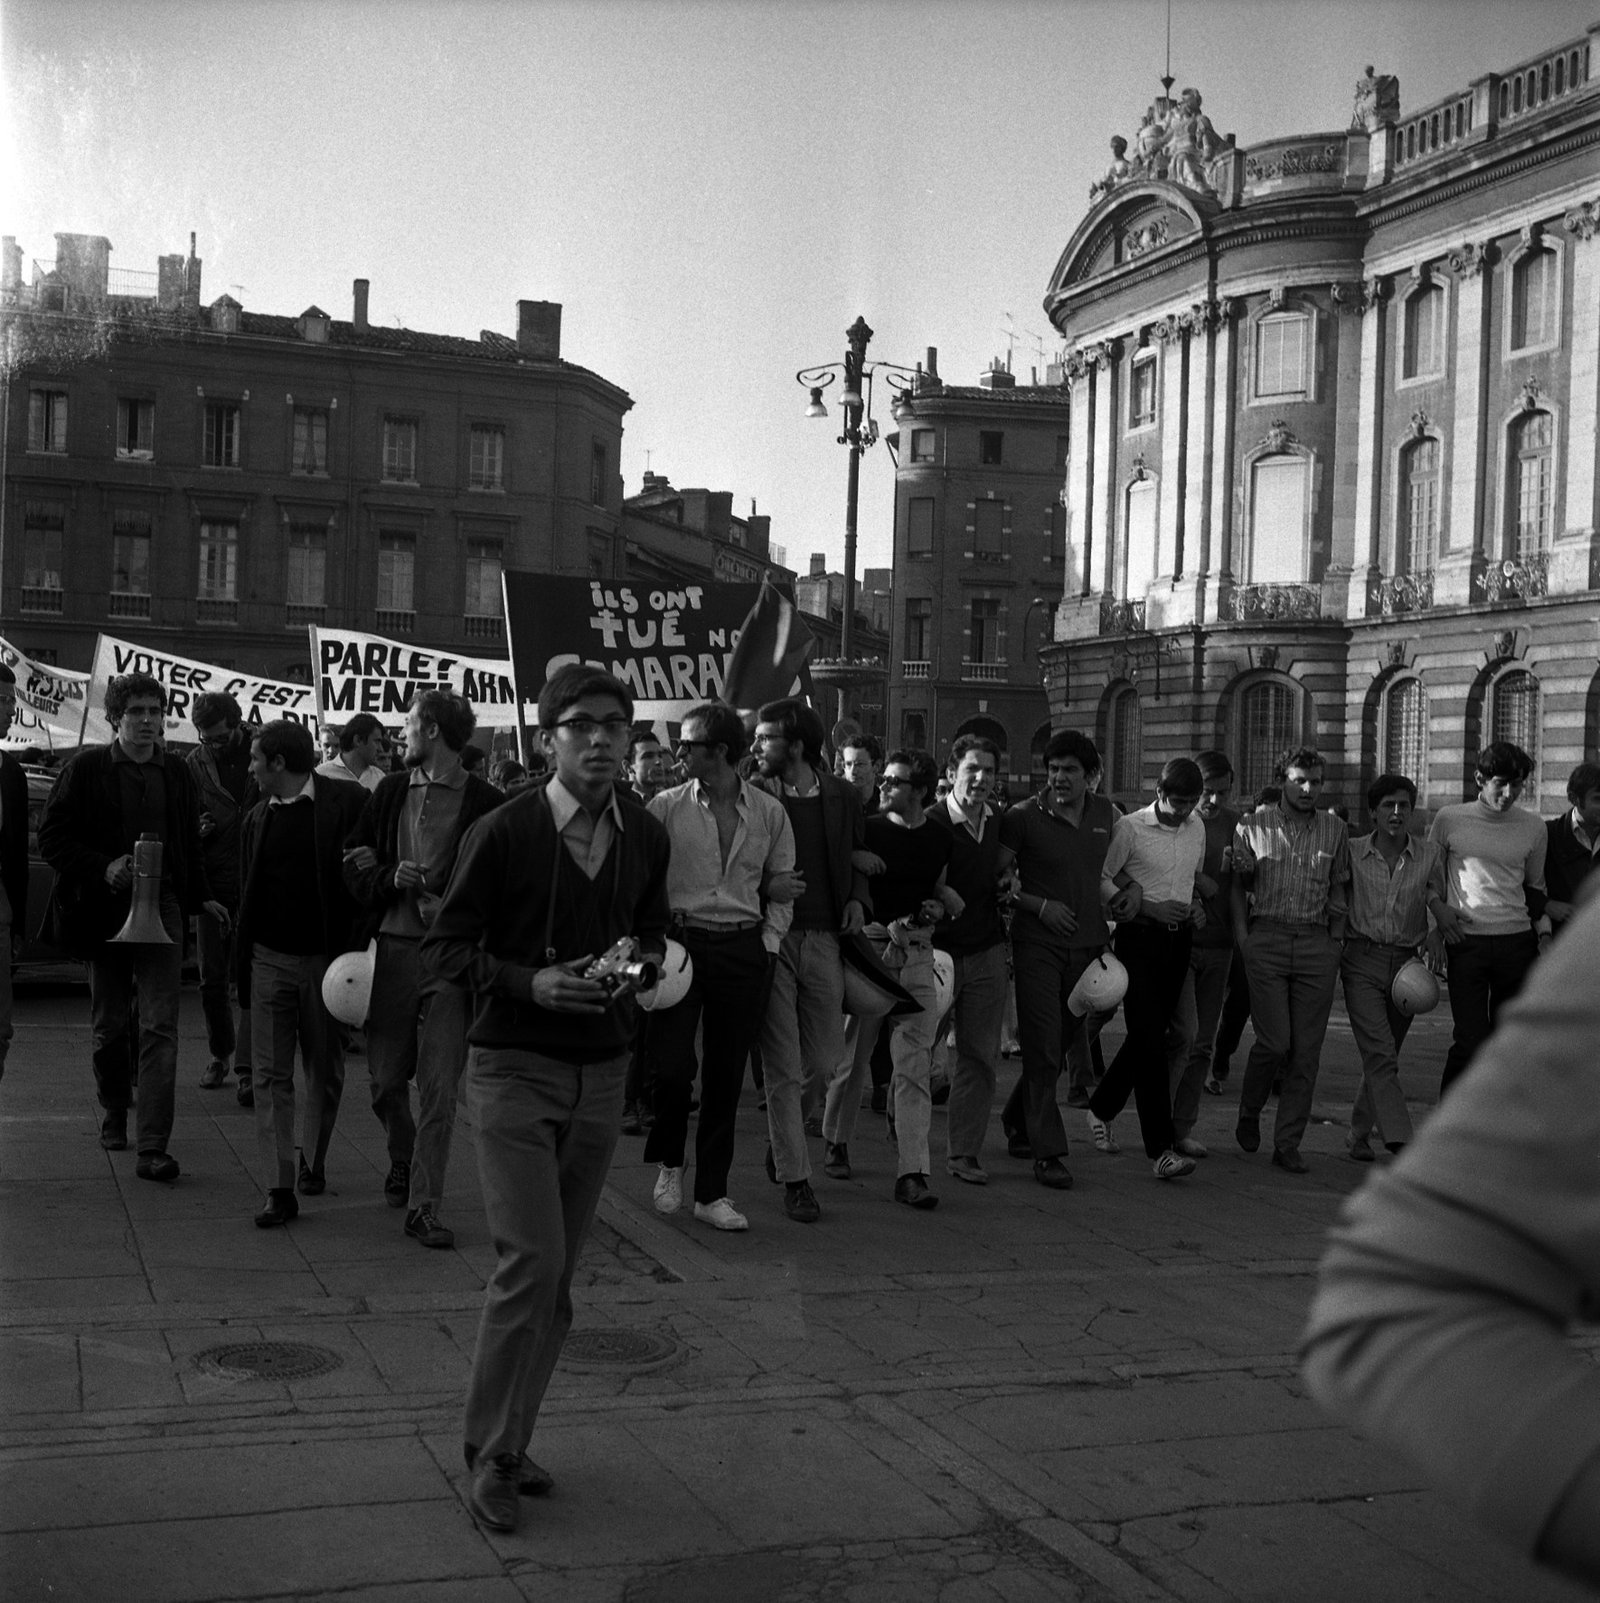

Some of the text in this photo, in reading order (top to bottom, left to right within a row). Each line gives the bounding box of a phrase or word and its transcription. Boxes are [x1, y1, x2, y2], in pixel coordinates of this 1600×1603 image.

[650, 586, 703, 610] ONT
[709, 628, 742, 648] NO
[113, 645, 212, 691] VOTER
[224, 678, 311, 708] C'EST
